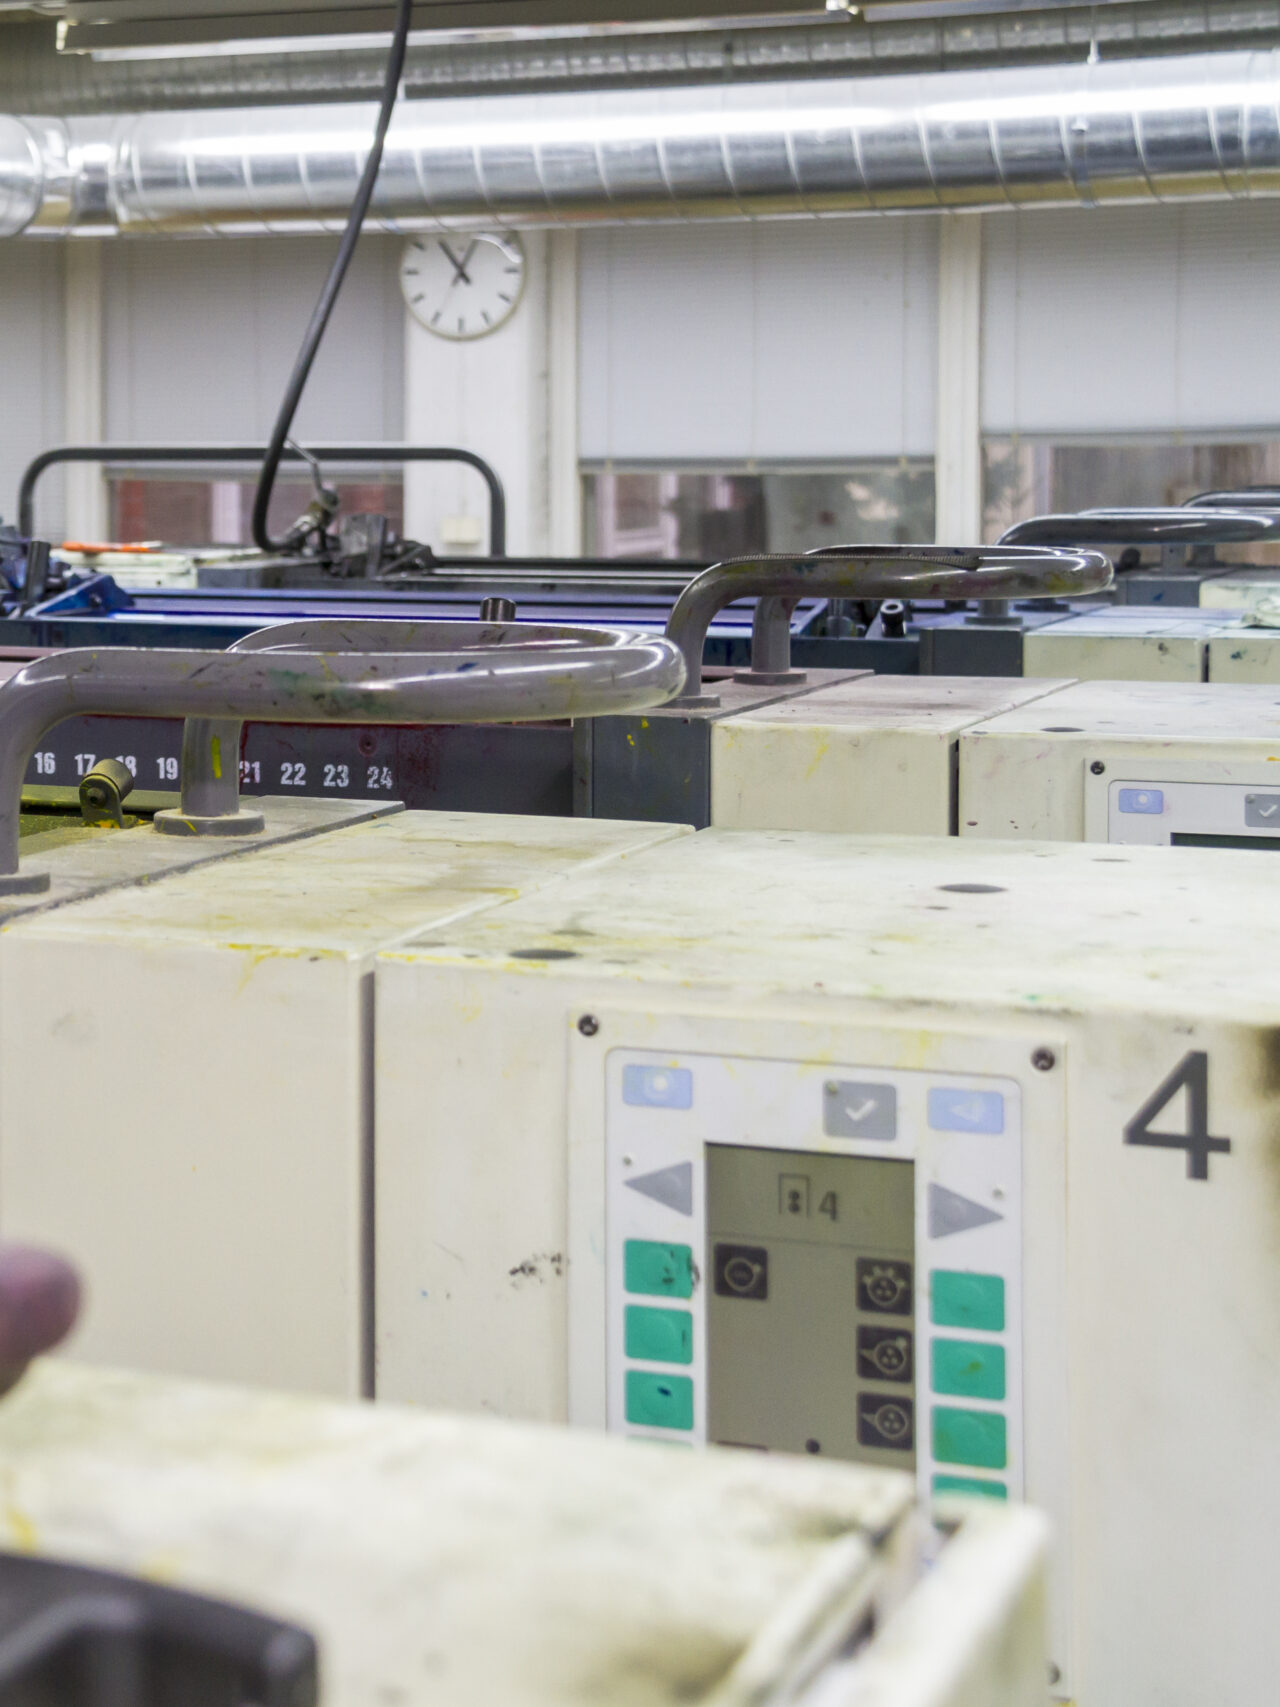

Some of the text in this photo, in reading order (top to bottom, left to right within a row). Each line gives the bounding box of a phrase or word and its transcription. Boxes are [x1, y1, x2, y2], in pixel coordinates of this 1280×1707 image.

[34, 752, 56, 775] 16
[74, 753, 96, 776] 17
[156, 757, 178, 780] 19
[239, 761, 261, 784] 21
[280, 762, 306, 786] 22
[323, 764, 349, 787] 23
[367, 766, 393, 790] 24
[1123, 1050, 1231, 1181] 4
[819, 1191, 837, 1221] 4
